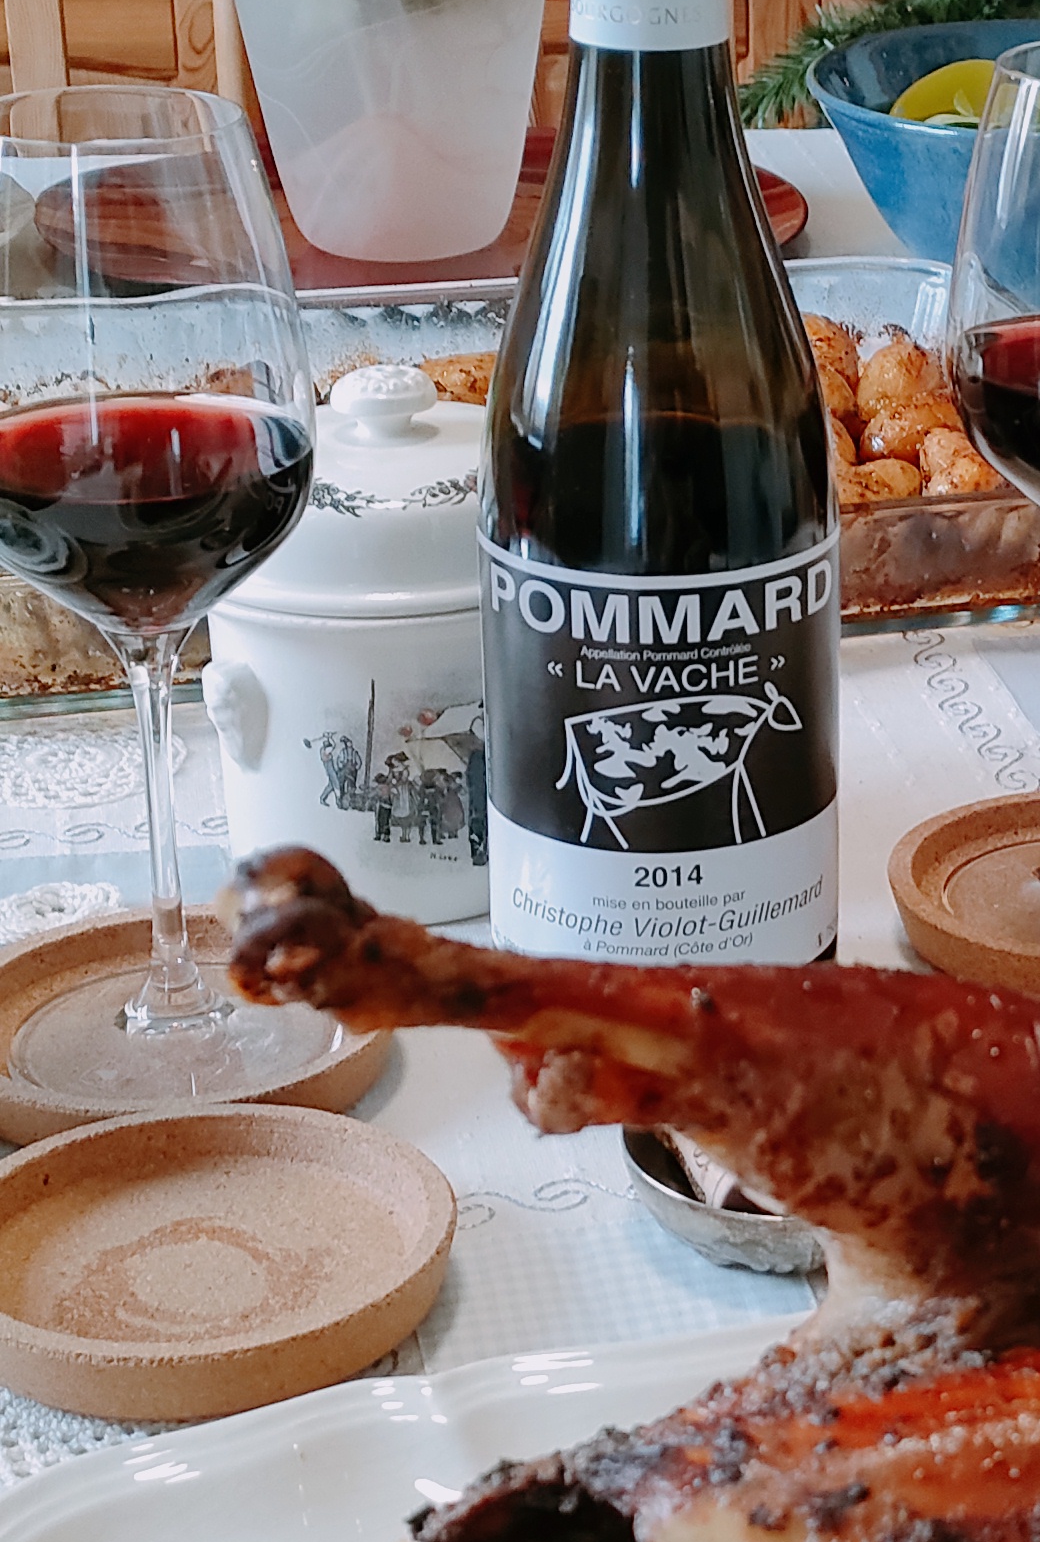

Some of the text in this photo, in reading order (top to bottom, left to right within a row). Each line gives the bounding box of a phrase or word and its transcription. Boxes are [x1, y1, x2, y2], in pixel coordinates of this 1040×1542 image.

[490, 559, 832, 645] POMMARD
[580, 644, 641, 662] Appellation
[642, 648, 698, 662] Pommard
[575, 659, 621, 692] LA
[629, 655, 759, 694] VACHE
[634, 864, 703, 888] 2014
[512, 887, 623, 936] Christophe
[634, 874, 824, 939] Violot-Guillemard
[592, 890, 746, 911] mise en bouteille par
[583, 932, 753, 958] à Pommard (Côte d'Or)
